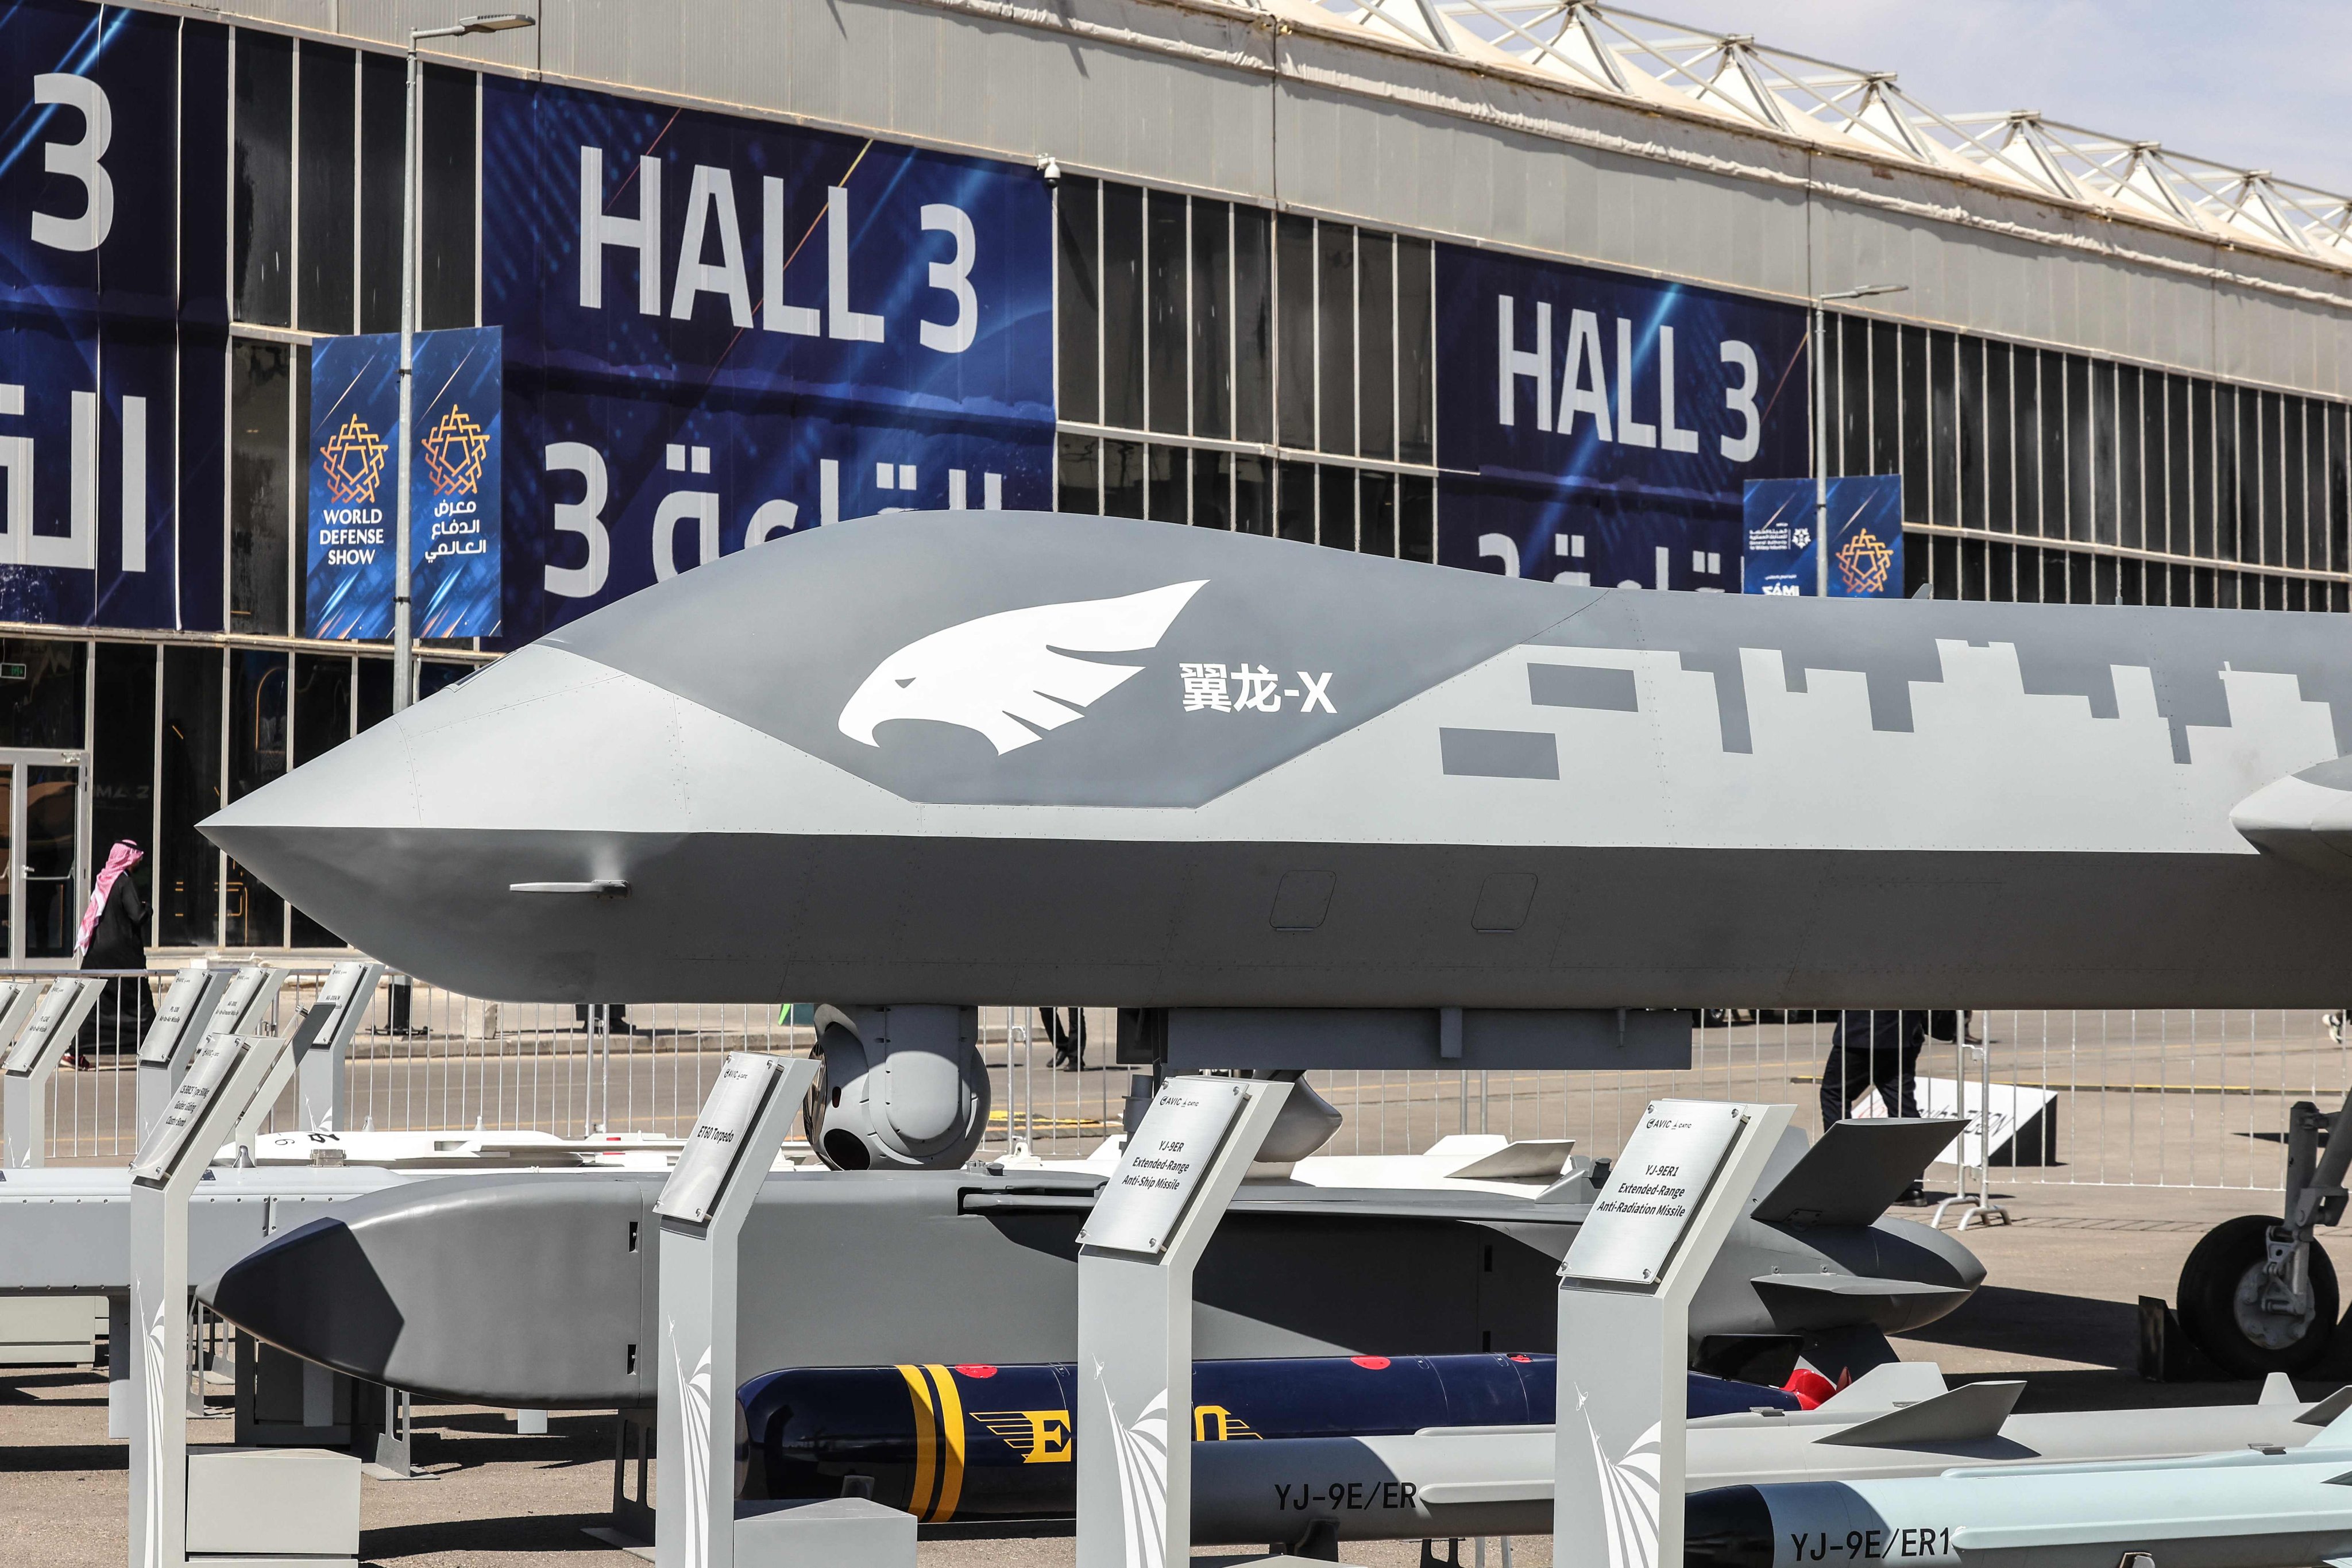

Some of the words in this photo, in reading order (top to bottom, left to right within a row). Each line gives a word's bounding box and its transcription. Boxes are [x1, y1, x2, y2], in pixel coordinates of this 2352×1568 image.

[32, 73, 114, 252] 3
[580, 145, 885, 343] HALL
[920, 204, 978, 353] 3
[1498, 295, 1699, 454] HALL
[1720, 339, 1761, 463] 3
[323, 509, 383, 524] WORLD
[434, 499, 477, 517] معرض
[544, 441, 610, 597] 3
[319, 528, 384, 545] DEFENSE
[431, 519, 480, 540] الدفاع
[328, 549, 376, 565] SHOW
[424, 539, 486, 563] العالمي
[1179, 663, 1338, 713] 翼龙-X
[1166, 1097, 1182, 1106] AVIC
[1653, 1119, 1672, 1128] AVIC
[697, 1125, 714, 1139] ET60
[710, 1127, 735, 1144] Torpedo
[1158, 1140, 1184, 1153] YJ-9ER
[1132, 1156, 1190, 1175] Extended-Range
[1645, 1164, 1680, 1177] YJ-9ER1
[1122, 1174, 1156, 1190] Anti-Ship
[1154, 1177, 1180, 1191] Missile
[1617, 1183, 1685, 1200] Extended-Range
[1596, 1200, 1658, 1215] Anti-Radiation
[1655, 1203, 1686, 1217] Missile
[1274, 1481, 1417, 1511] YJ-9E/ER
[1790, 1527, 1949, 1562] YJ-9E/ER1
